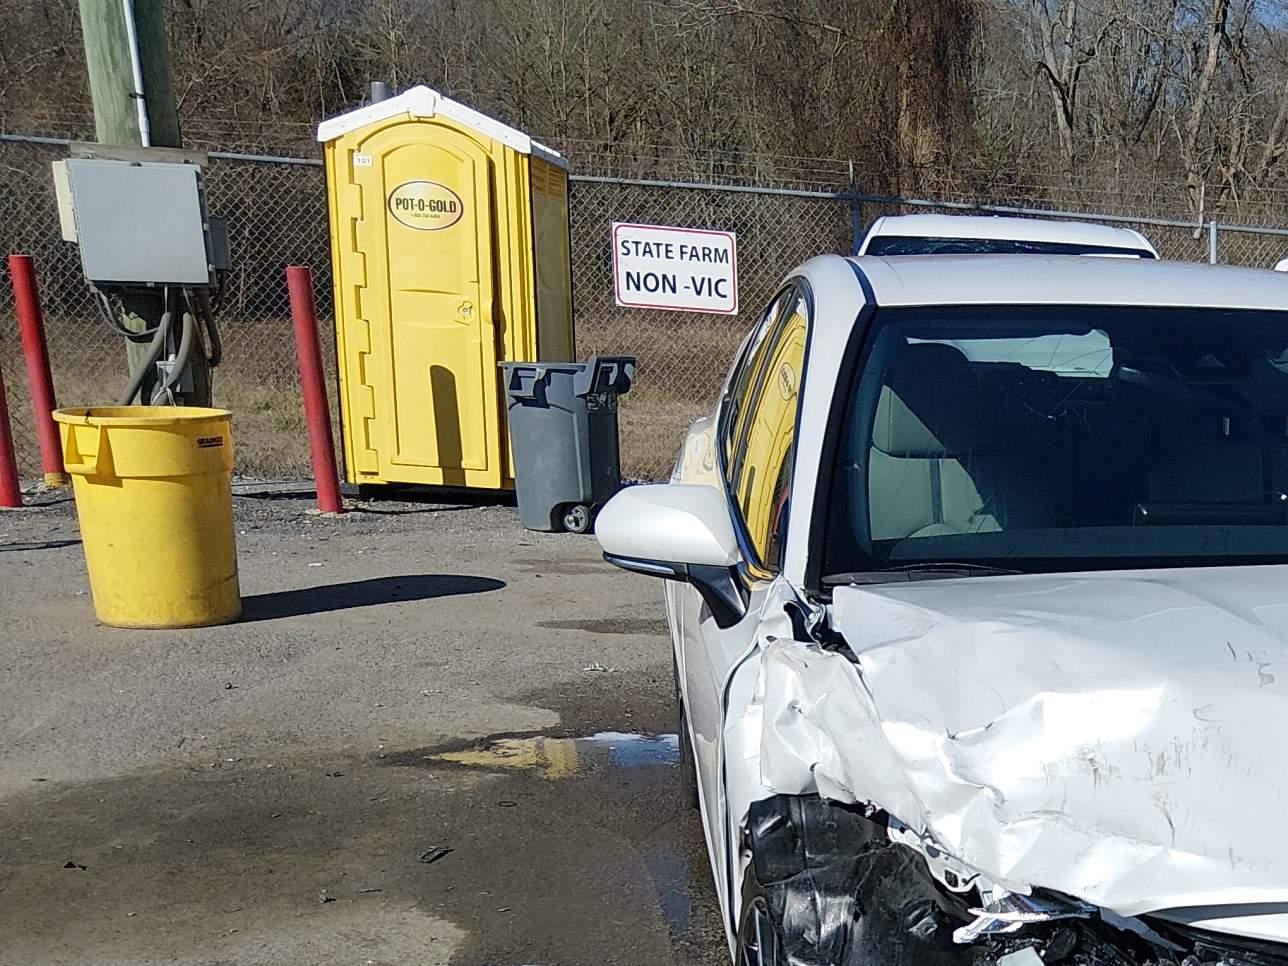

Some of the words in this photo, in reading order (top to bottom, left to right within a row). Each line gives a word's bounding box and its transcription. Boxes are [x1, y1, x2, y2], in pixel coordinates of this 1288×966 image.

[395, 197, 457, 213] POT-O-GOLD
[620, 240, 675, 260] STATE
[679, 244, 729, 265] FARM
[625, 271, 677, 294] NON
[683, 276, 728, 299] -VIC
